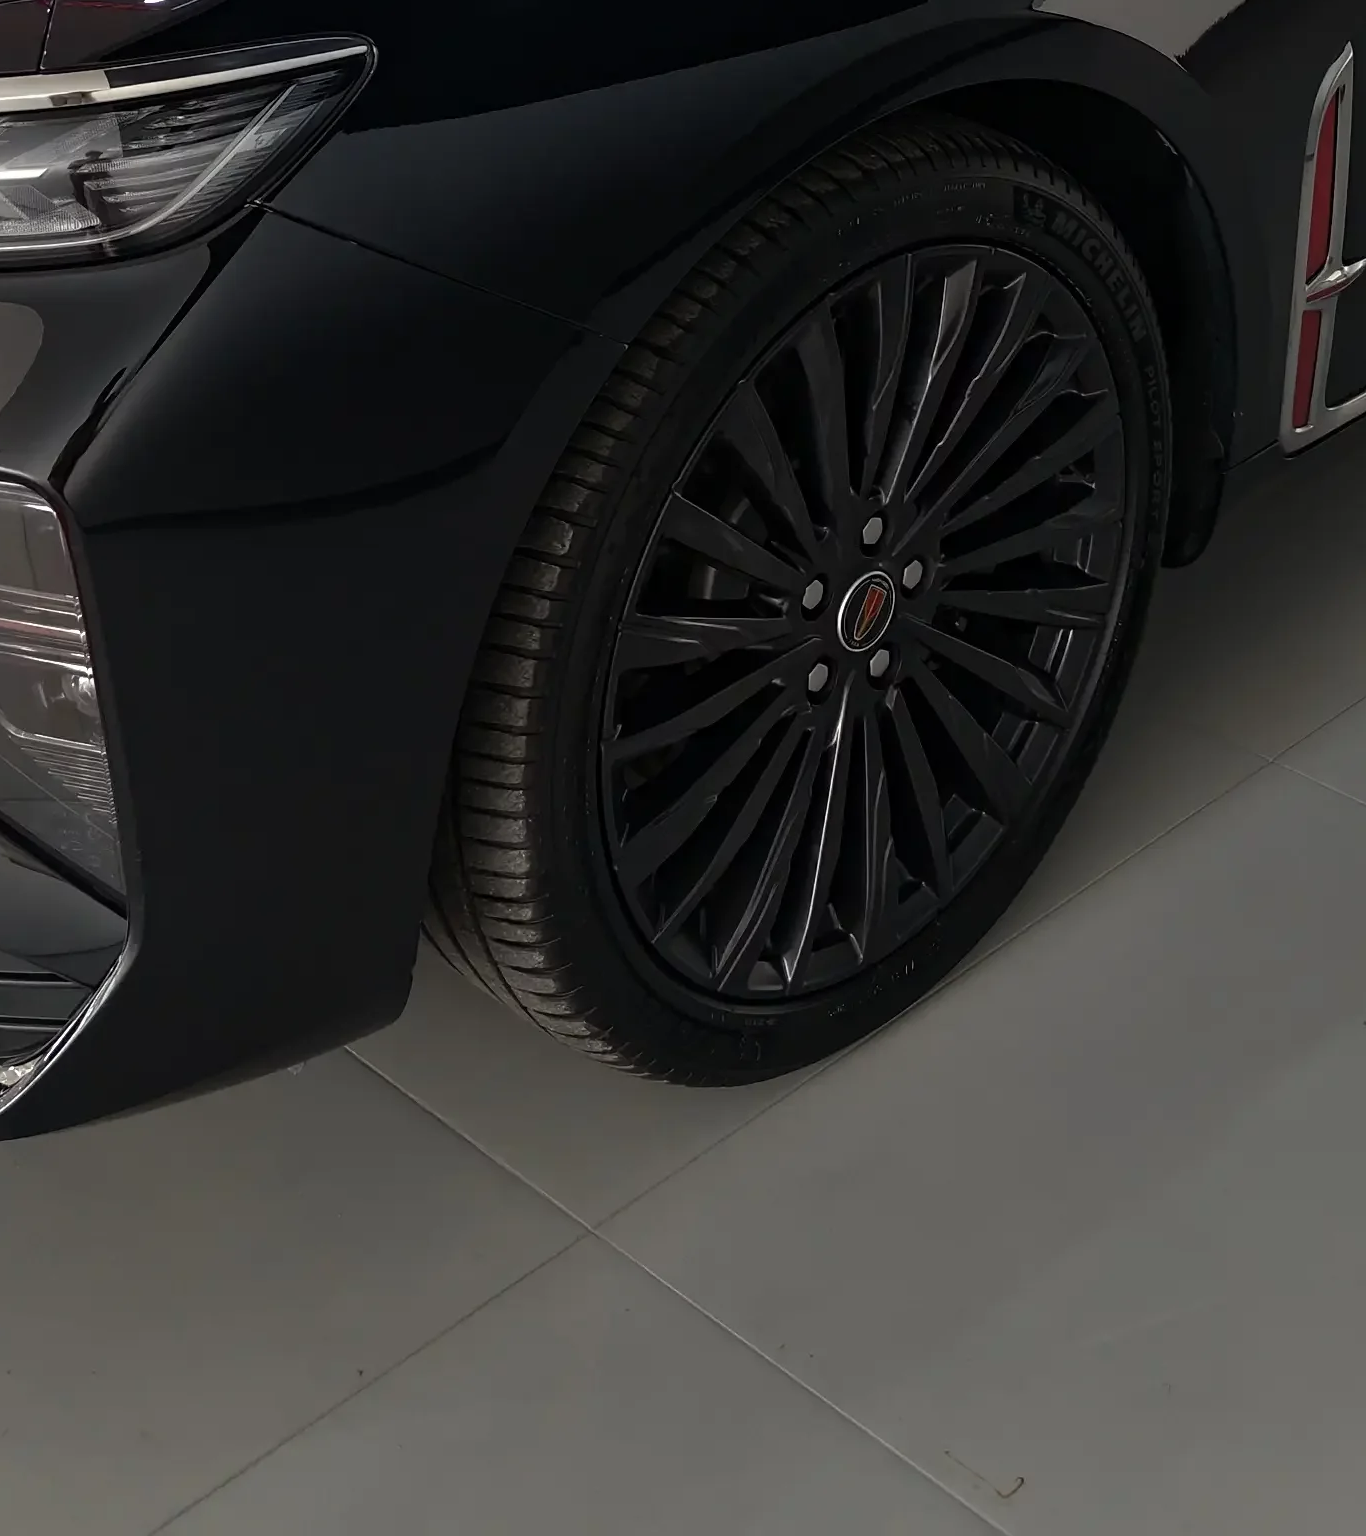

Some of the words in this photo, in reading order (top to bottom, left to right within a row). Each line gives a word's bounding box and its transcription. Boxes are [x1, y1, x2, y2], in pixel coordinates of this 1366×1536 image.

[1052, 211, 1148, 344] MICHELIN
[1143, 364, 1165, 434] PILOT
[1149, 439, 1167, 526] SPORT
